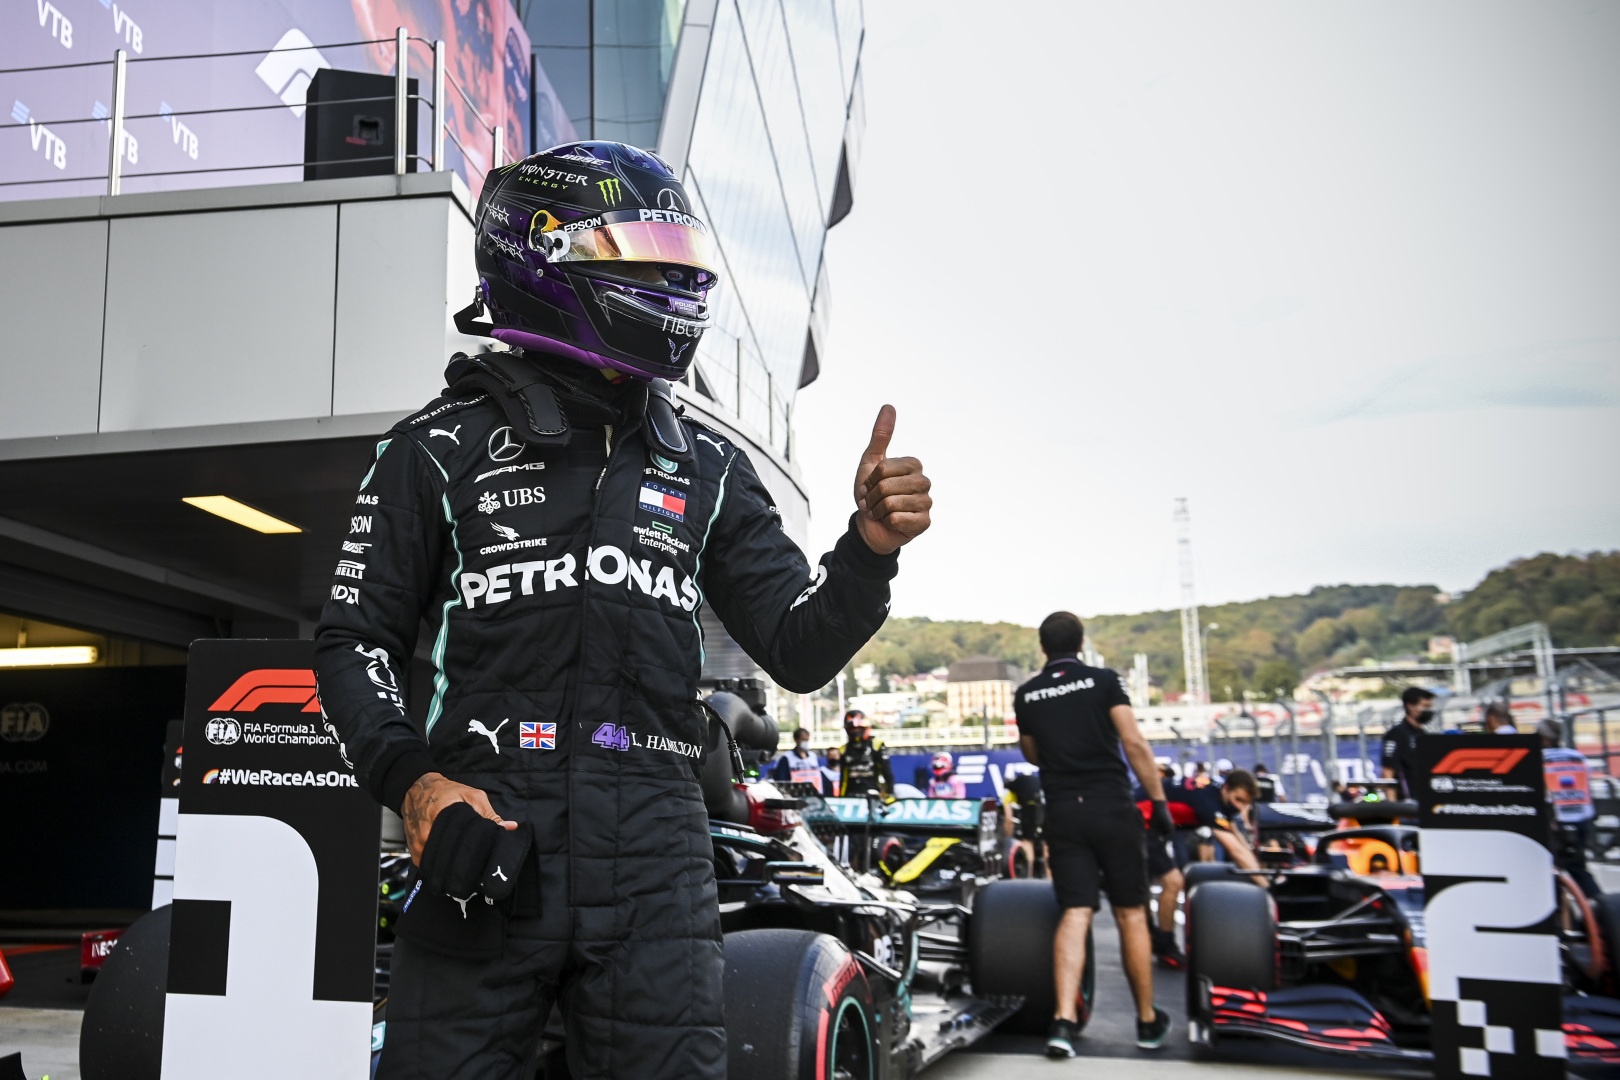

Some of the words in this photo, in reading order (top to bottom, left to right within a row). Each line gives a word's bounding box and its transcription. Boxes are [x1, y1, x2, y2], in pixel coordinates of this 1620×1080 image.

[37, 0, 73, 49] VTB
[113, 3, 143, 54] VTB
[30, 117, 66, 170] VTB
[172, 115, 198, 160] VTB
[518, 176, 569, 190] ENERGY
[564, 217, 602, 233] EPSON
[643, 467, 691, 486] ETRONAS
[502, 486, 546, 507] UBS
[645, 482, 683, 497] TOMMY
[642, 503, 681, 520] HILFIGER
[633, 525, 661, 540] ewlett
[480, 538, 548, 556] CROWDSTRIKE
[638, 534, 678, 557] Enterprise
[460, 545, 699, 612] PETRONAS
[1024, 677, 1096, 704] PETRONAS
[243, 723, 262, 733] FIA
[264, 723, 308, 734] Formula
[309, 723, 317, 734] 1
[592, 722, 630, 752] 44
[631, 732, 643, 747] L.
[243, 734, 275, 744] World
